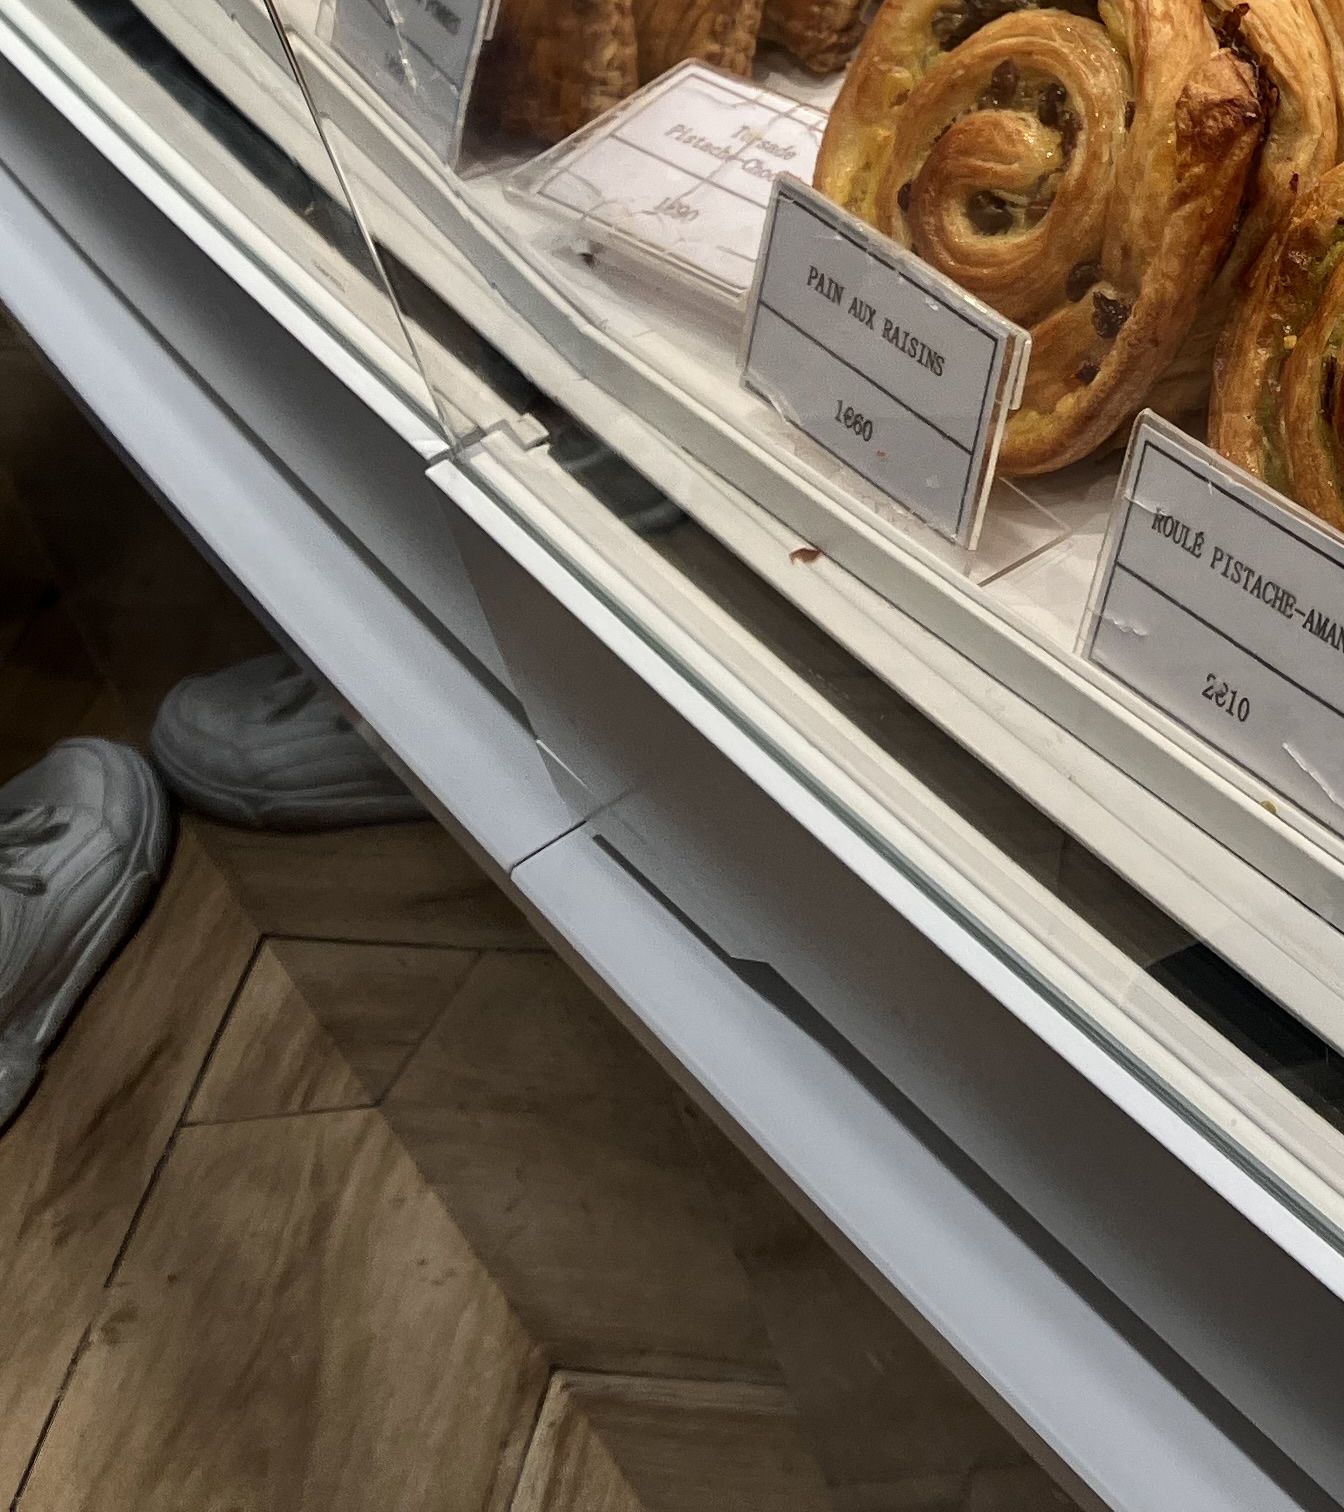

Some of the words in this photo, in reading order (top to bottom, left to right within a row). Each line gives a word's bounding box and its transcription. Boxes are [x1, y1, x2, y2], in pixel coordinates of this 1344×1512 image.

[806, 264, 845, 307] PAIN
[848, 296, 876, 330] AUX
[882, 317, 946, 378] RAISINS
[1151, 509, 1205, 559] ROULÉ
